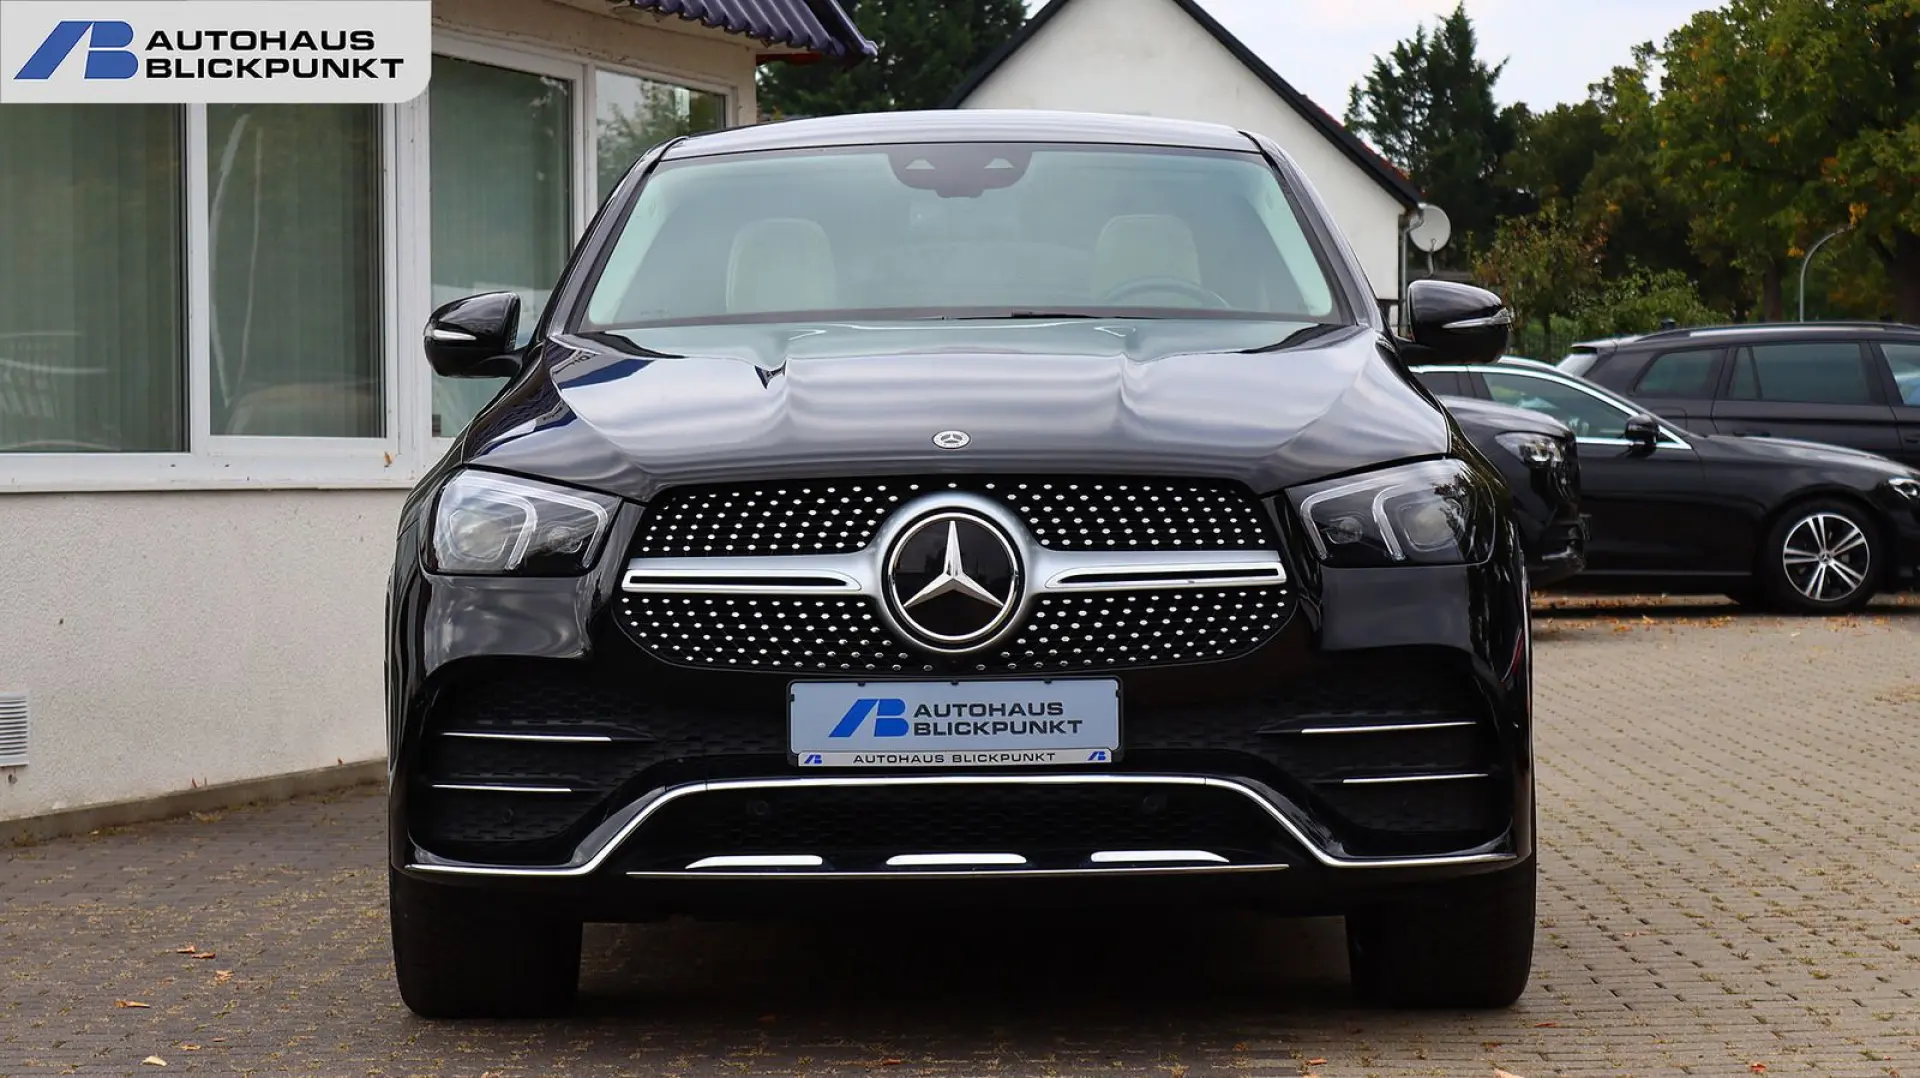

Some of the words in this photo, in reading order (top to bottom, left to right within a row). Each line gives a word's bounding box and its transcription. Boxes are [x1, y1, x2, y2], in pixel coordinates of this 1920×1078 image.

[913, 701, 1064, 718] AUTOHAUS
[913, 719, 1083, 737] BLICKPUNKT
[852, 754, 945, 764] AUTOHAUS
[952, 752, 1056, 763] BLICKPUNKT
